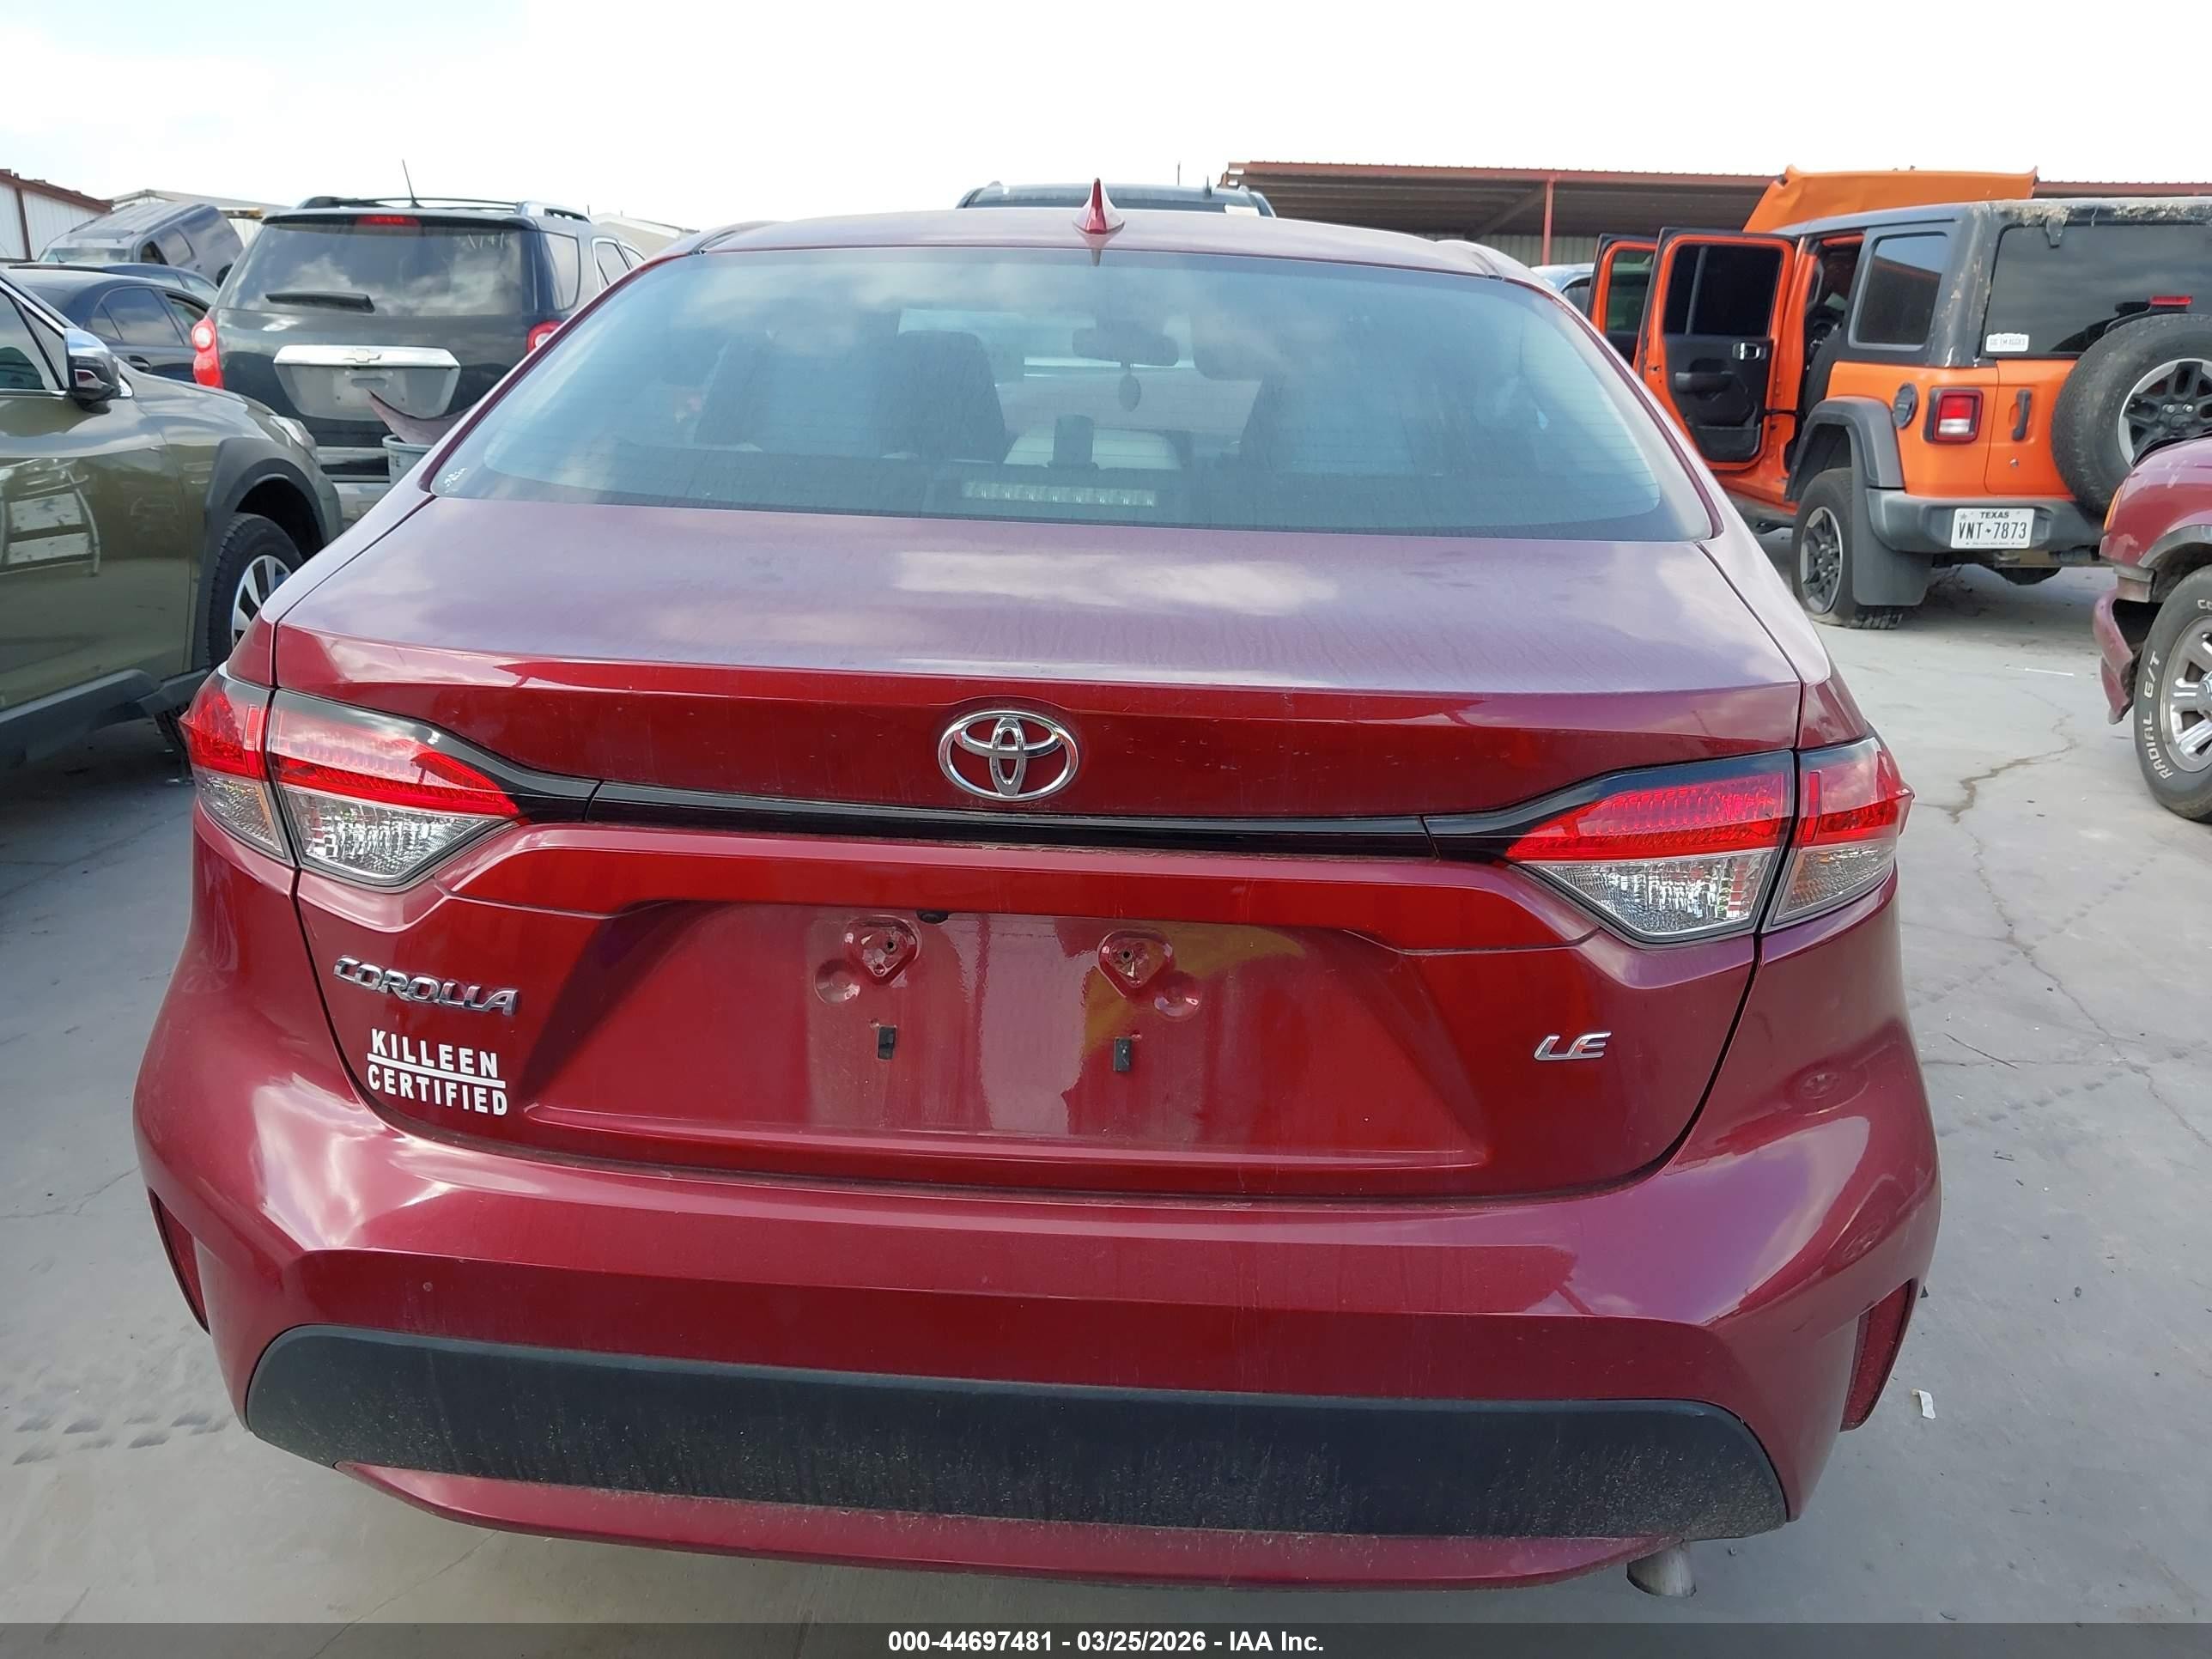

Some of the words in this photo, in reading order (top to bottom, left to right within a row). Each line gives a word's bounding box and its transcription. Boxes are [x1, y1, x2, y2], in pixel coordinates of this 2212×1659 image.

[2143, 651, 2160, 698] G/T
[2143, 711, 2173, 779] RADIAL
[333, 956, 519, 1017] COROLLA
[371, 1028, 498, 1079] KILLEEN
[1534, 1030, 1612, 1061] LE
[368, 1064, 508, 1116] CERTIFIED
